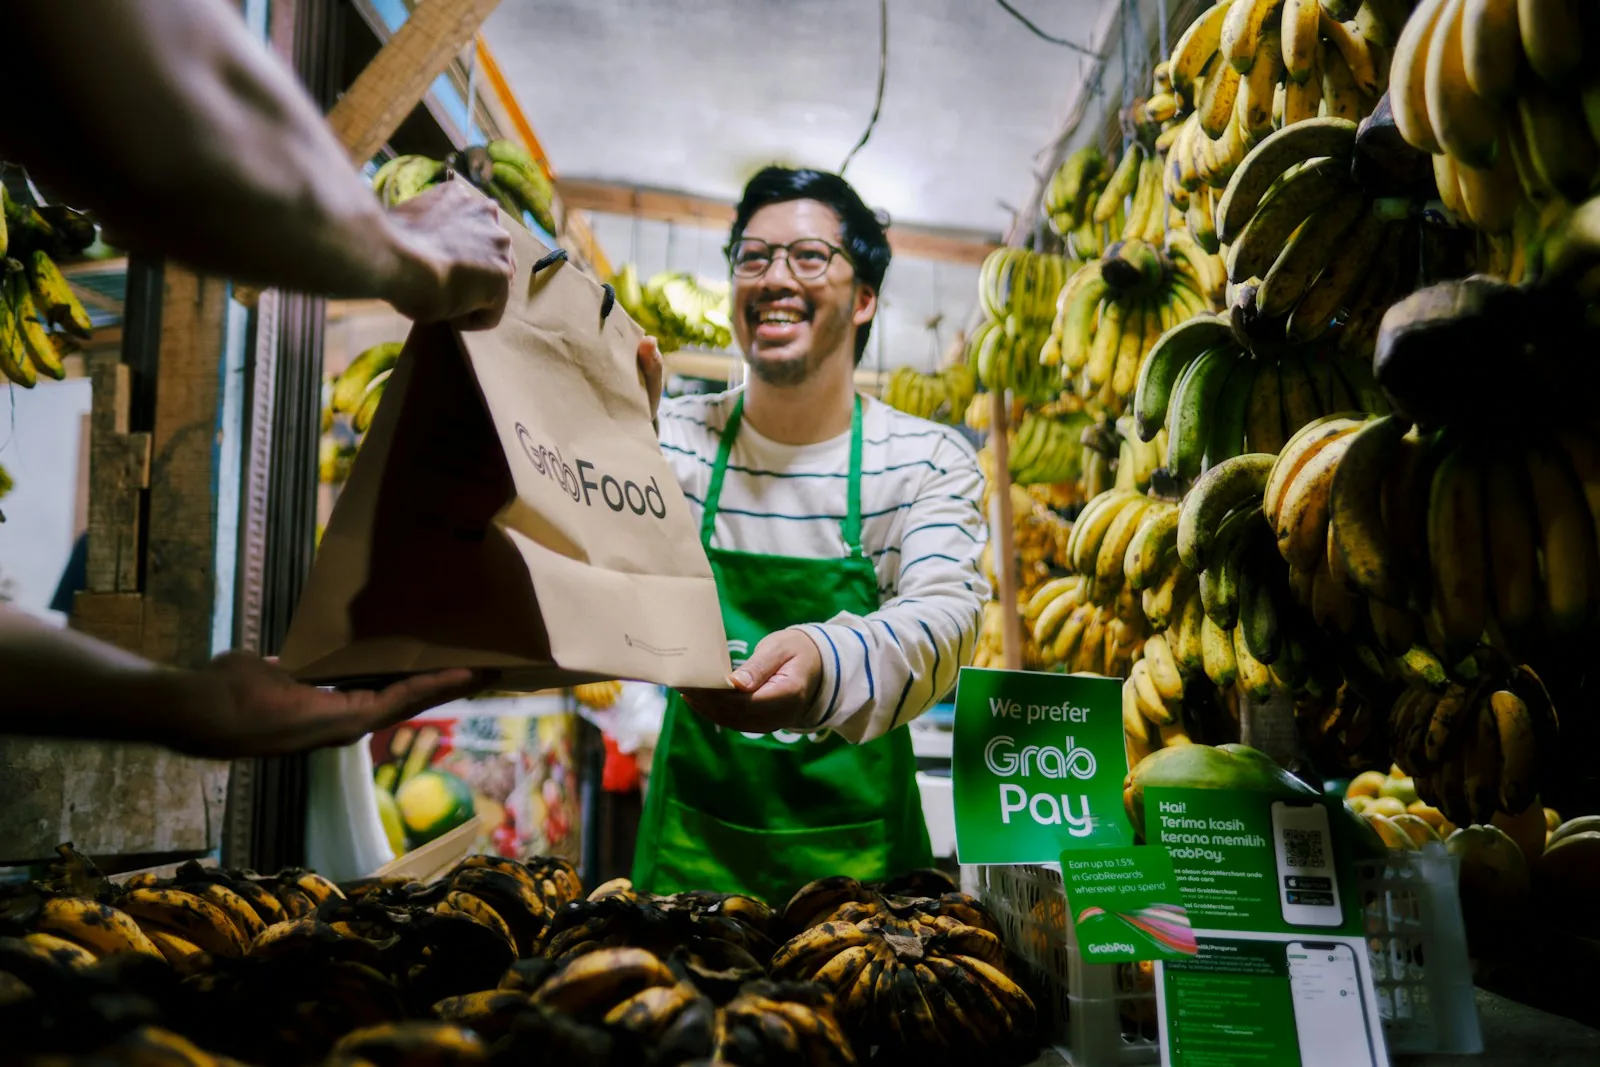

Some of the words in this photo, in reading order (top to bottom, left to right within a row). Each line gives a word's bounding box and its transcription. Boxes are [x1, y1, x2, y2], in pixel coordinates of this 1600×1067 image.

[515, 421, 666, 519] GrabFood
[988, 697, 1022, 718] We
[1027, 701, 1091, 725] prefer
[984, 735, 1097, 780] Grab
[999, 783, 1093, 838] Pay
[1159, 801, 1186, 813] Hai!
[1160, 816, 1207, 829] Terima
[1208, 817, 1245, 831] kasih
[1160, 830, 1209, 844] kerana
[1212, 834, 1266, 847] memilih
[1068, 860, 1090, 869] Earn
[1091, 861, 1104, 870] up
[1105, 859, 1115, 868] to
[1071, 873, 1080, 881] in
[1081, 870, 1144, 881] GrabRewards
[1201, 869, 1246, 877] GrabMerchant
[1074, 884, 1116, 894] wherever
[1119, 885, 1136, 894] you
[1137, 882, 1166, 893] spend
[1088, 942, 1135, 955] GrabPay
